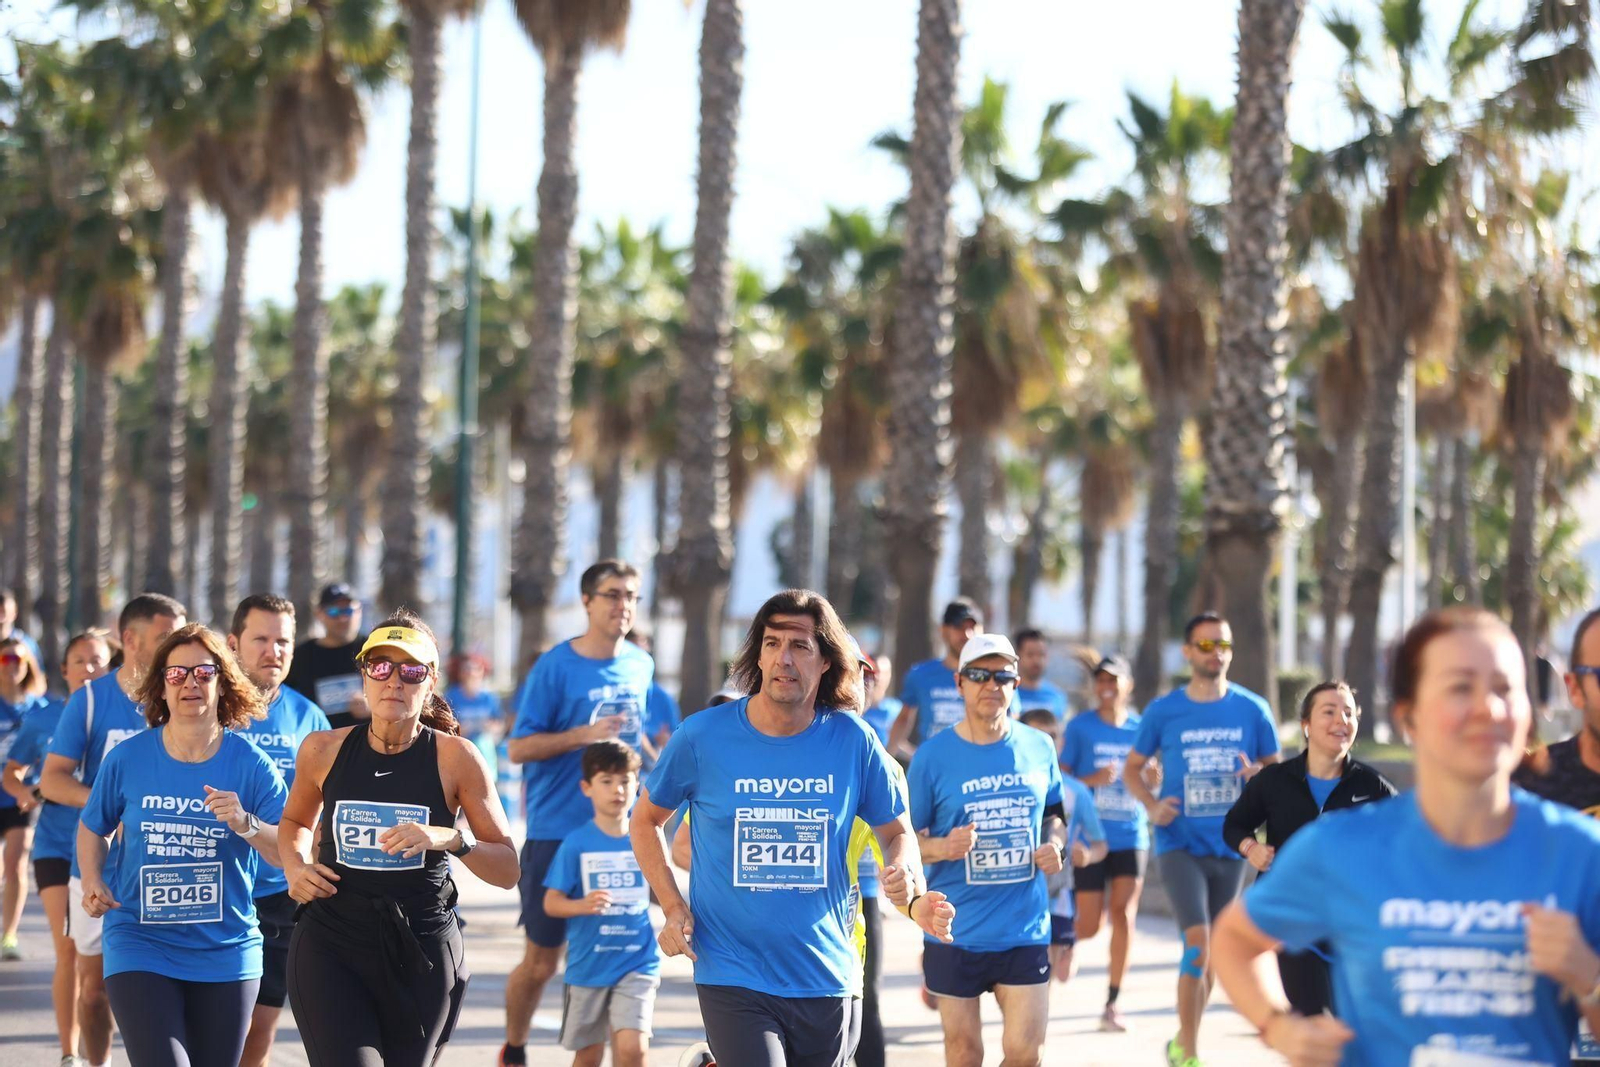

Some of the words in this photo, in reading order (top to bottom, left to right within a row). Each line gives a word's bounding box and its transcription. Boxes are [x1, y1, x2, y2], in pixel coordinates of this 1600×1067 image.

[238, 731, 296, 748] ayoral
[735, 774, 834, 799] mayoral
[350, 815, 382, 824] Solidaria
[351, 809, 377, 817] Carrera
[394, 809, 423, 817] mayoral
[736, 807, 830, 820] RUNNING
[141, 822, 225, 839] RUNNING
[344, 826, 377, 847] 21
[148, 834, 217, 848] MAKES
[147, 845, 217, 858] FRIENDS
[746, 844, 816, 863] 2144
[975, 849, 1025, 867] 2117
[597, 872, 636, 888] 969
[151, 885, 212, 904] 2046
